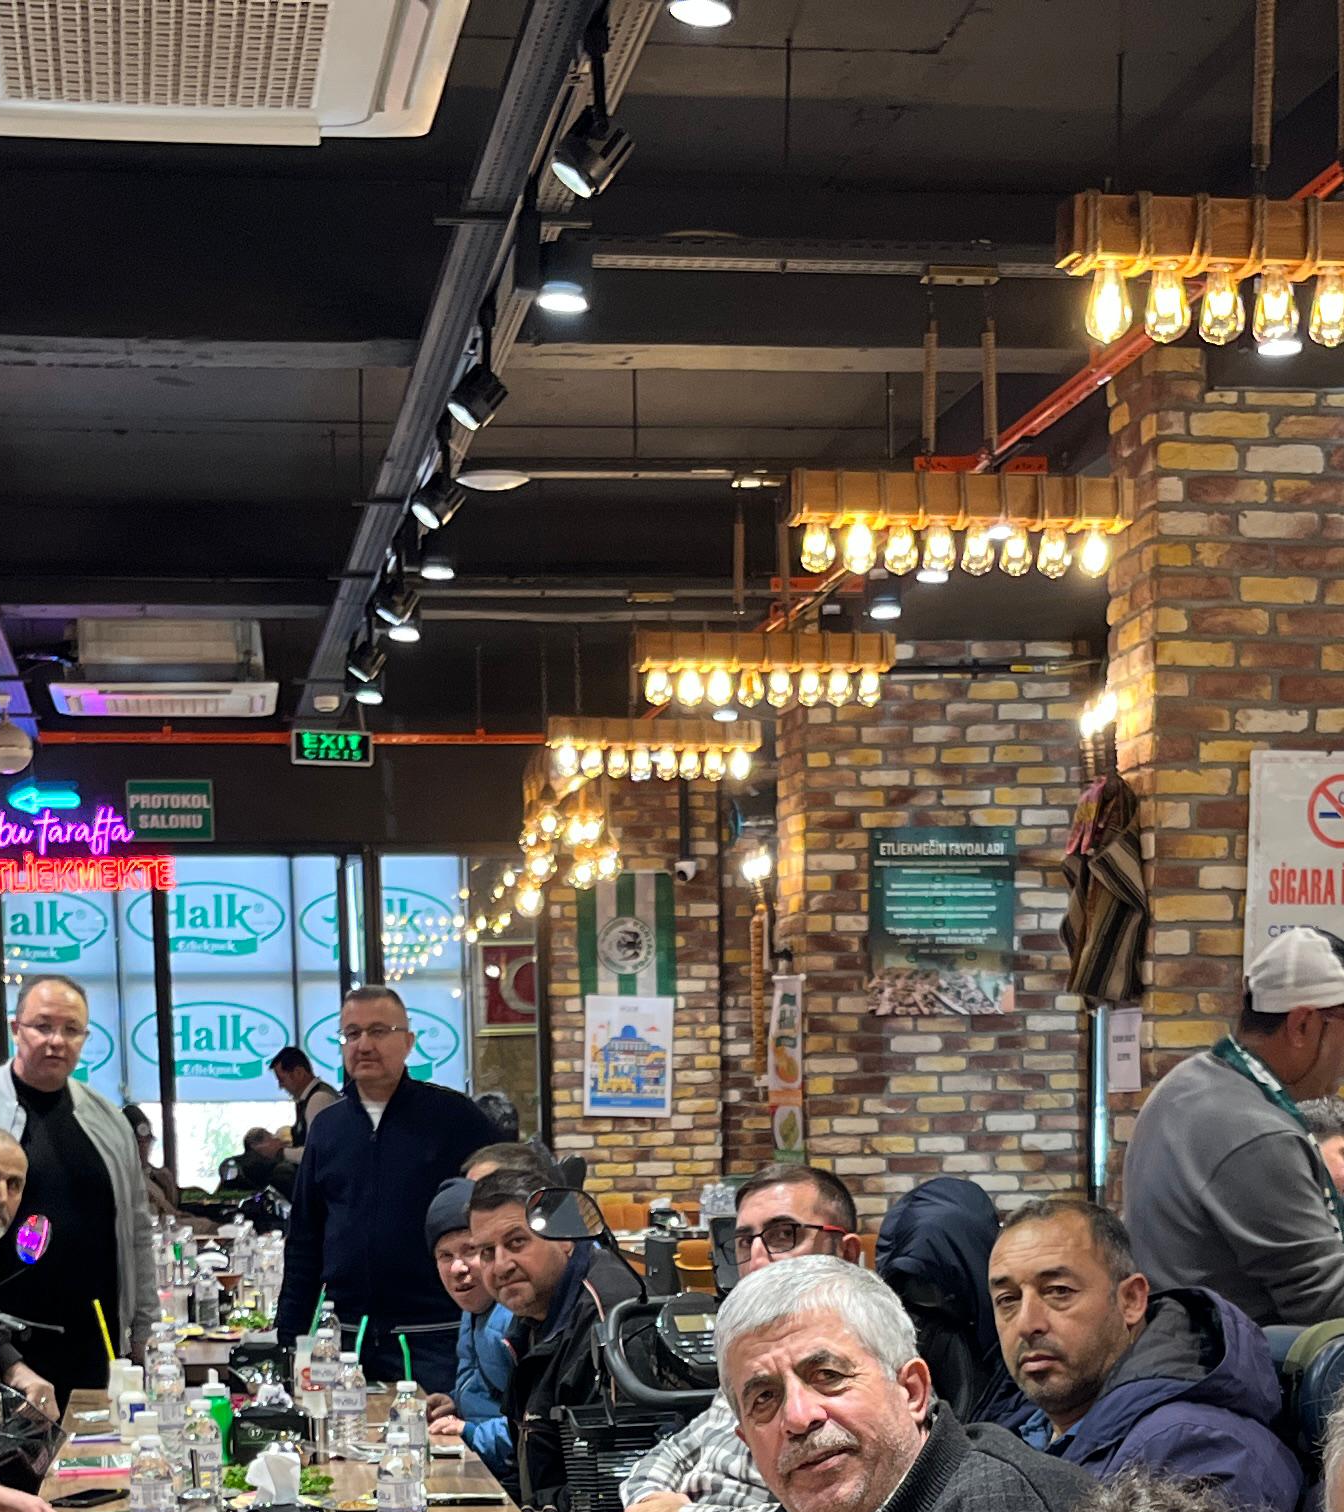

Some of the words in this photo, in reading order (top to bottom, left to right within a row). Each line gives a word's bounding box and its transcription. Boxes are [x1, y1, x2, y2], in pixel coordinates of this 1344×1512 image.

[302, 732, 362, 750] EXIT
[129, 793, 211, 808] PROTOKOL
[34, 805, 136, 855] tarafta
[138, 814, 203, 829] SALONU
[1269, 862, 1336, 905] SİGARA
[9, 901, 84, 942] alk
